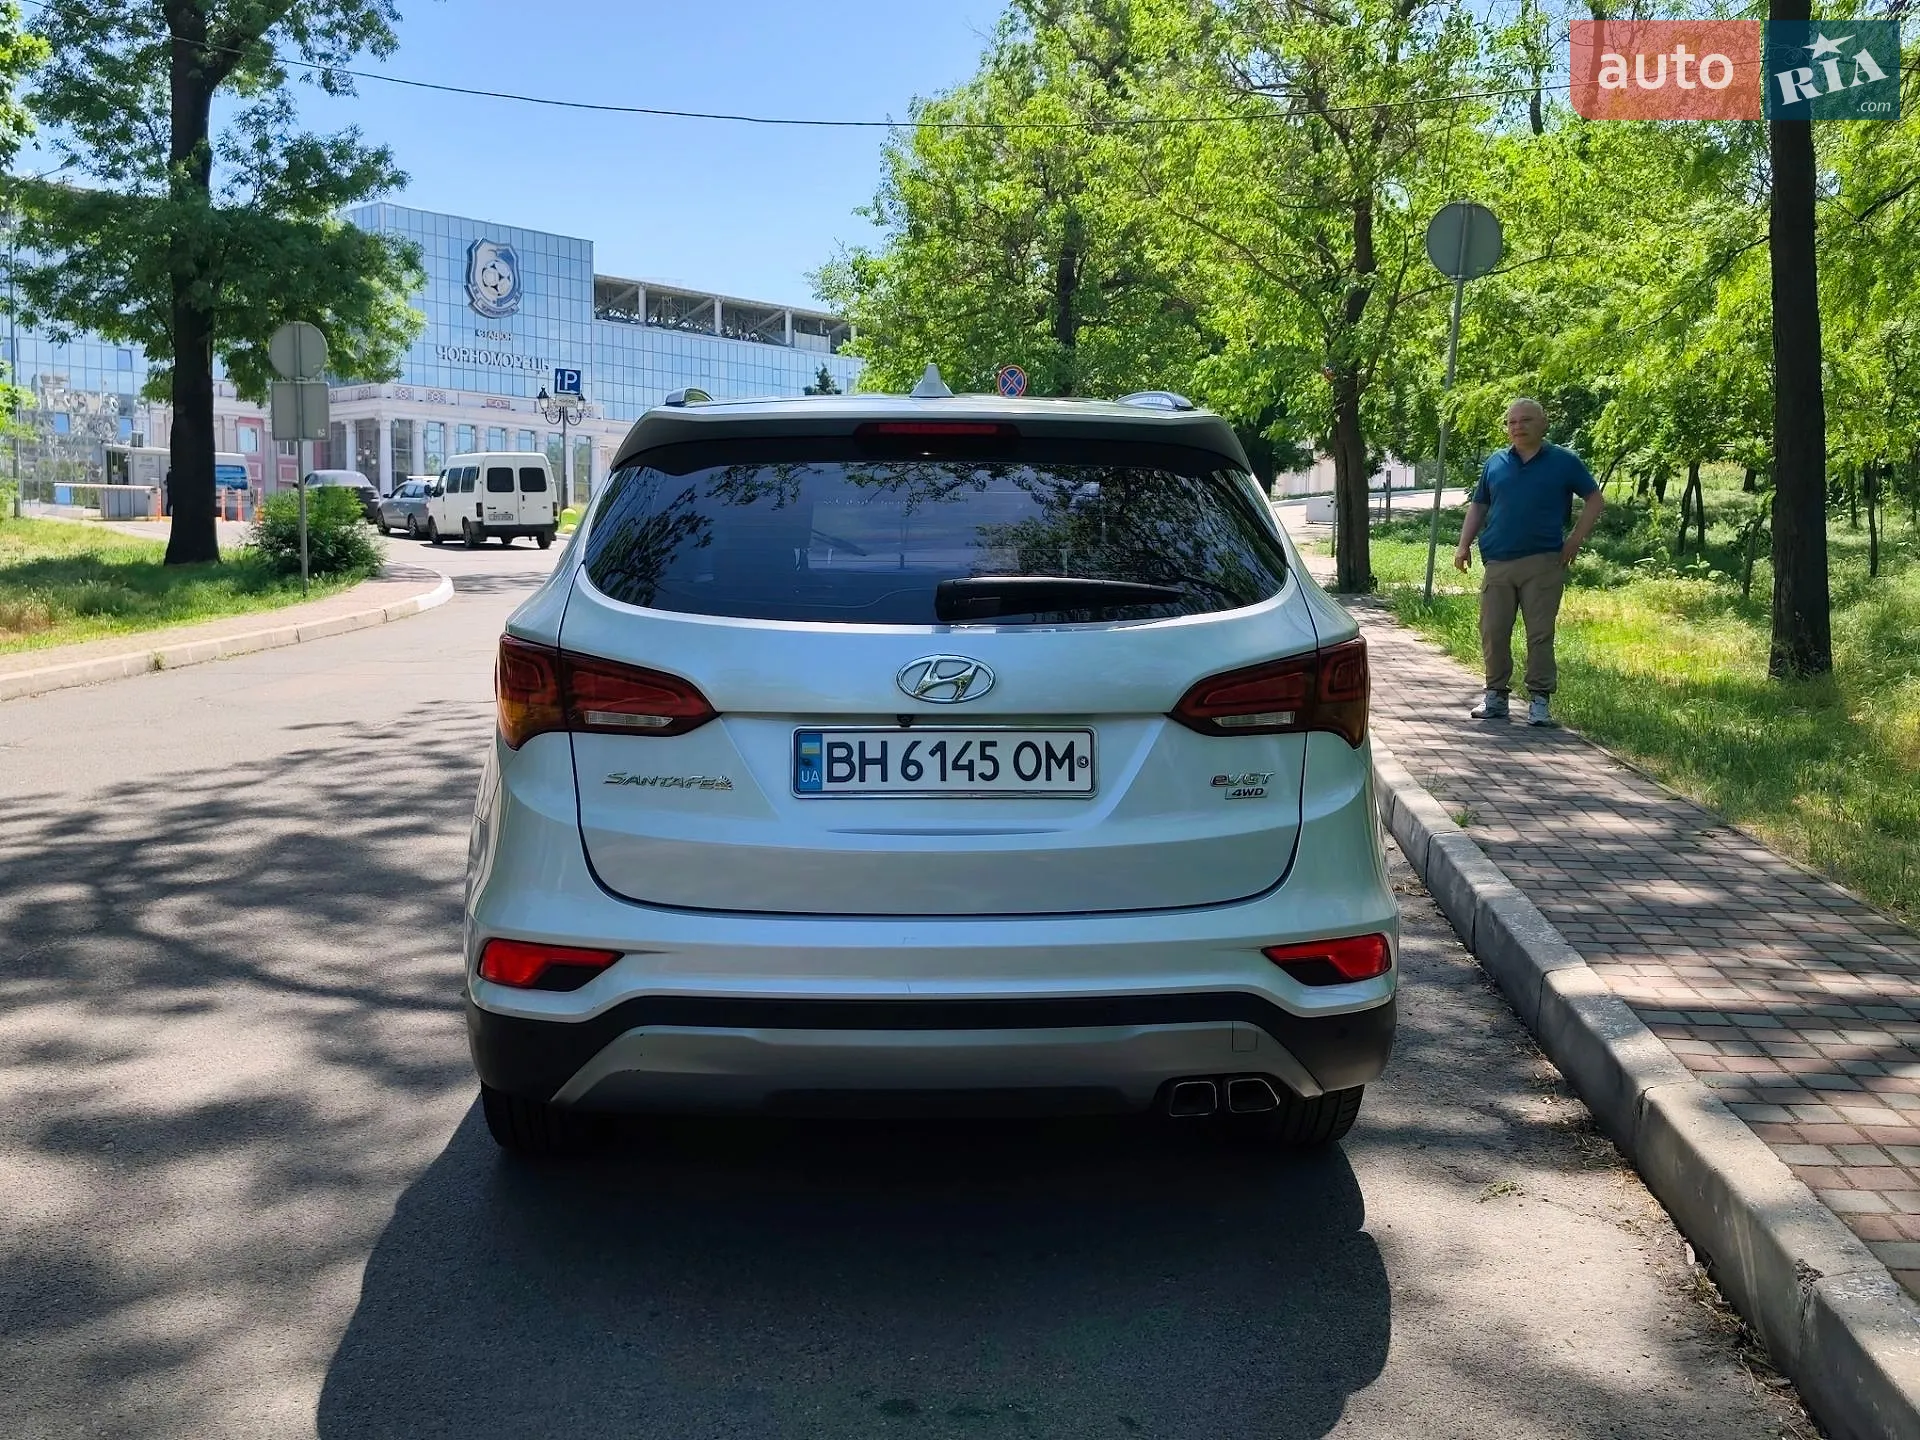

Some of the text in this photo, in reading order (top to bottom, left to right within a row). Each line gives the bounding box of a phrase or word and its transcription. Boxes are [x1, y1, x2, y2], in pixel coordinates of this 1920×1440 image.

[436, 345, 549, 374] ЧОРНОМОРЕЦЬ
[564, 370, 578, 390] P
[826, 740, 1075, 783] BH 6145 OM
[801, 769, 820, 783] UA
[1231, 787, 1264, 797] 4WD
